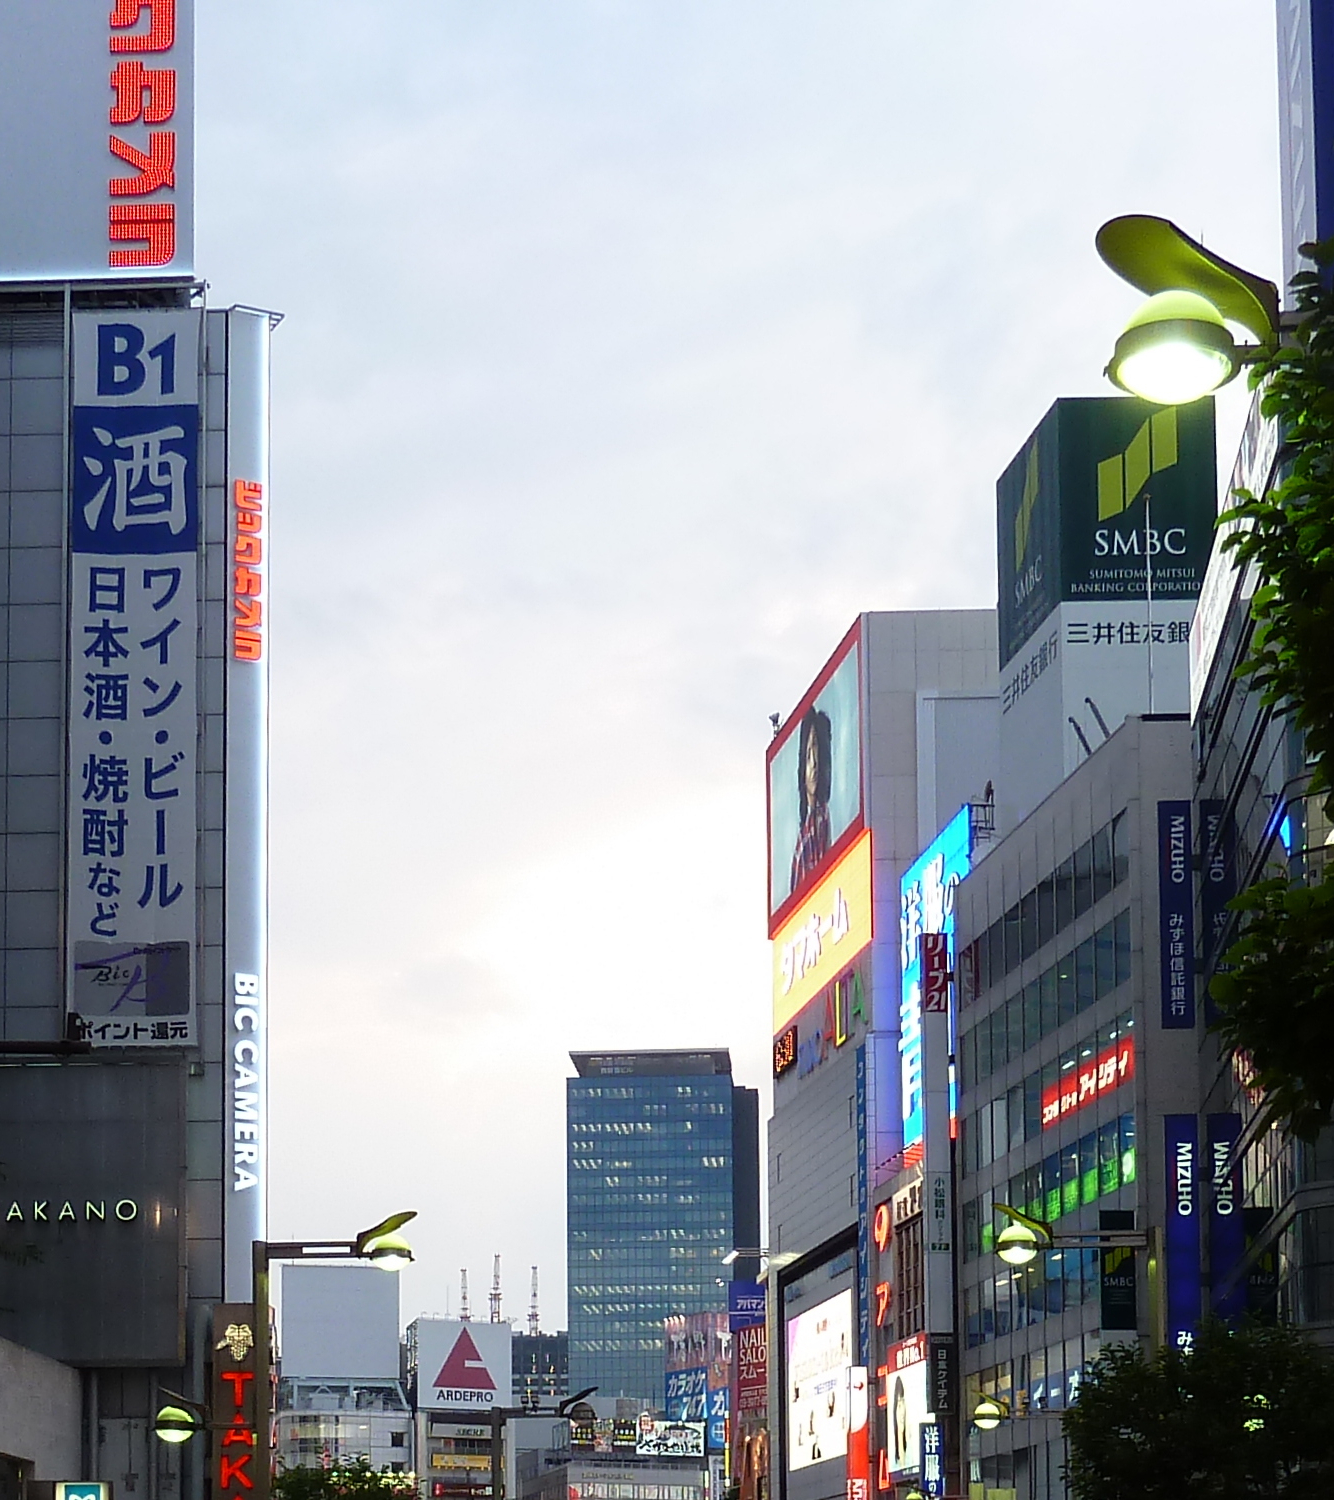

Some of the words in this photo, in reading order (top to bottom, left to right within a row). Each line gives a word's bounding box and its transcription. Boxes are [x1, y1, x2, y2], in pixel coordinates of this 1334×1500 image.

[97, 323, 176, 396] B1
[83, 425, 188, 536] 酒
[234, 479, 262, 661] ビックカメラ
[1089, 568, 1153, 579] SUMITOMO
[1156, 568, 1196, 578] MITSUI
[1094, 527, 1186, 557] SMBC
[1014, 554, 1042, 609] SMBC
[1070, 583, 1124, 594] BANKING
[1066, 621, 1189, 645] 三井住友銀
[1002, 629, 1059, 715] 三井住友銀行
[81, 565, 131, 938] 日本酒・焼酎など
[137, 566, 185, 910] ワイン・ビール
[1170, 815, 1185, 884] MIZUHO
[926, 935, 947, 1011] リーブ21
[1169, 912, 1186, 1017] みずほ信託銀行
[234, 972, 260, 1033] BIC
[234, 1039, 260, 1192] CAMERA
[1176, 1140, 1194, 1217] MIZUHO
[1103, 1276, 1134, 1287] SMBC
[739, 1327, 767, 1349] NAIL
[739, 1345, 767, 1366] SALO
[436, 1389, 494, 1403] ARDEPRO
[666, 1369, 707, 1399] カラオケ
[924, 1425, 941, 1500] 洋服の
